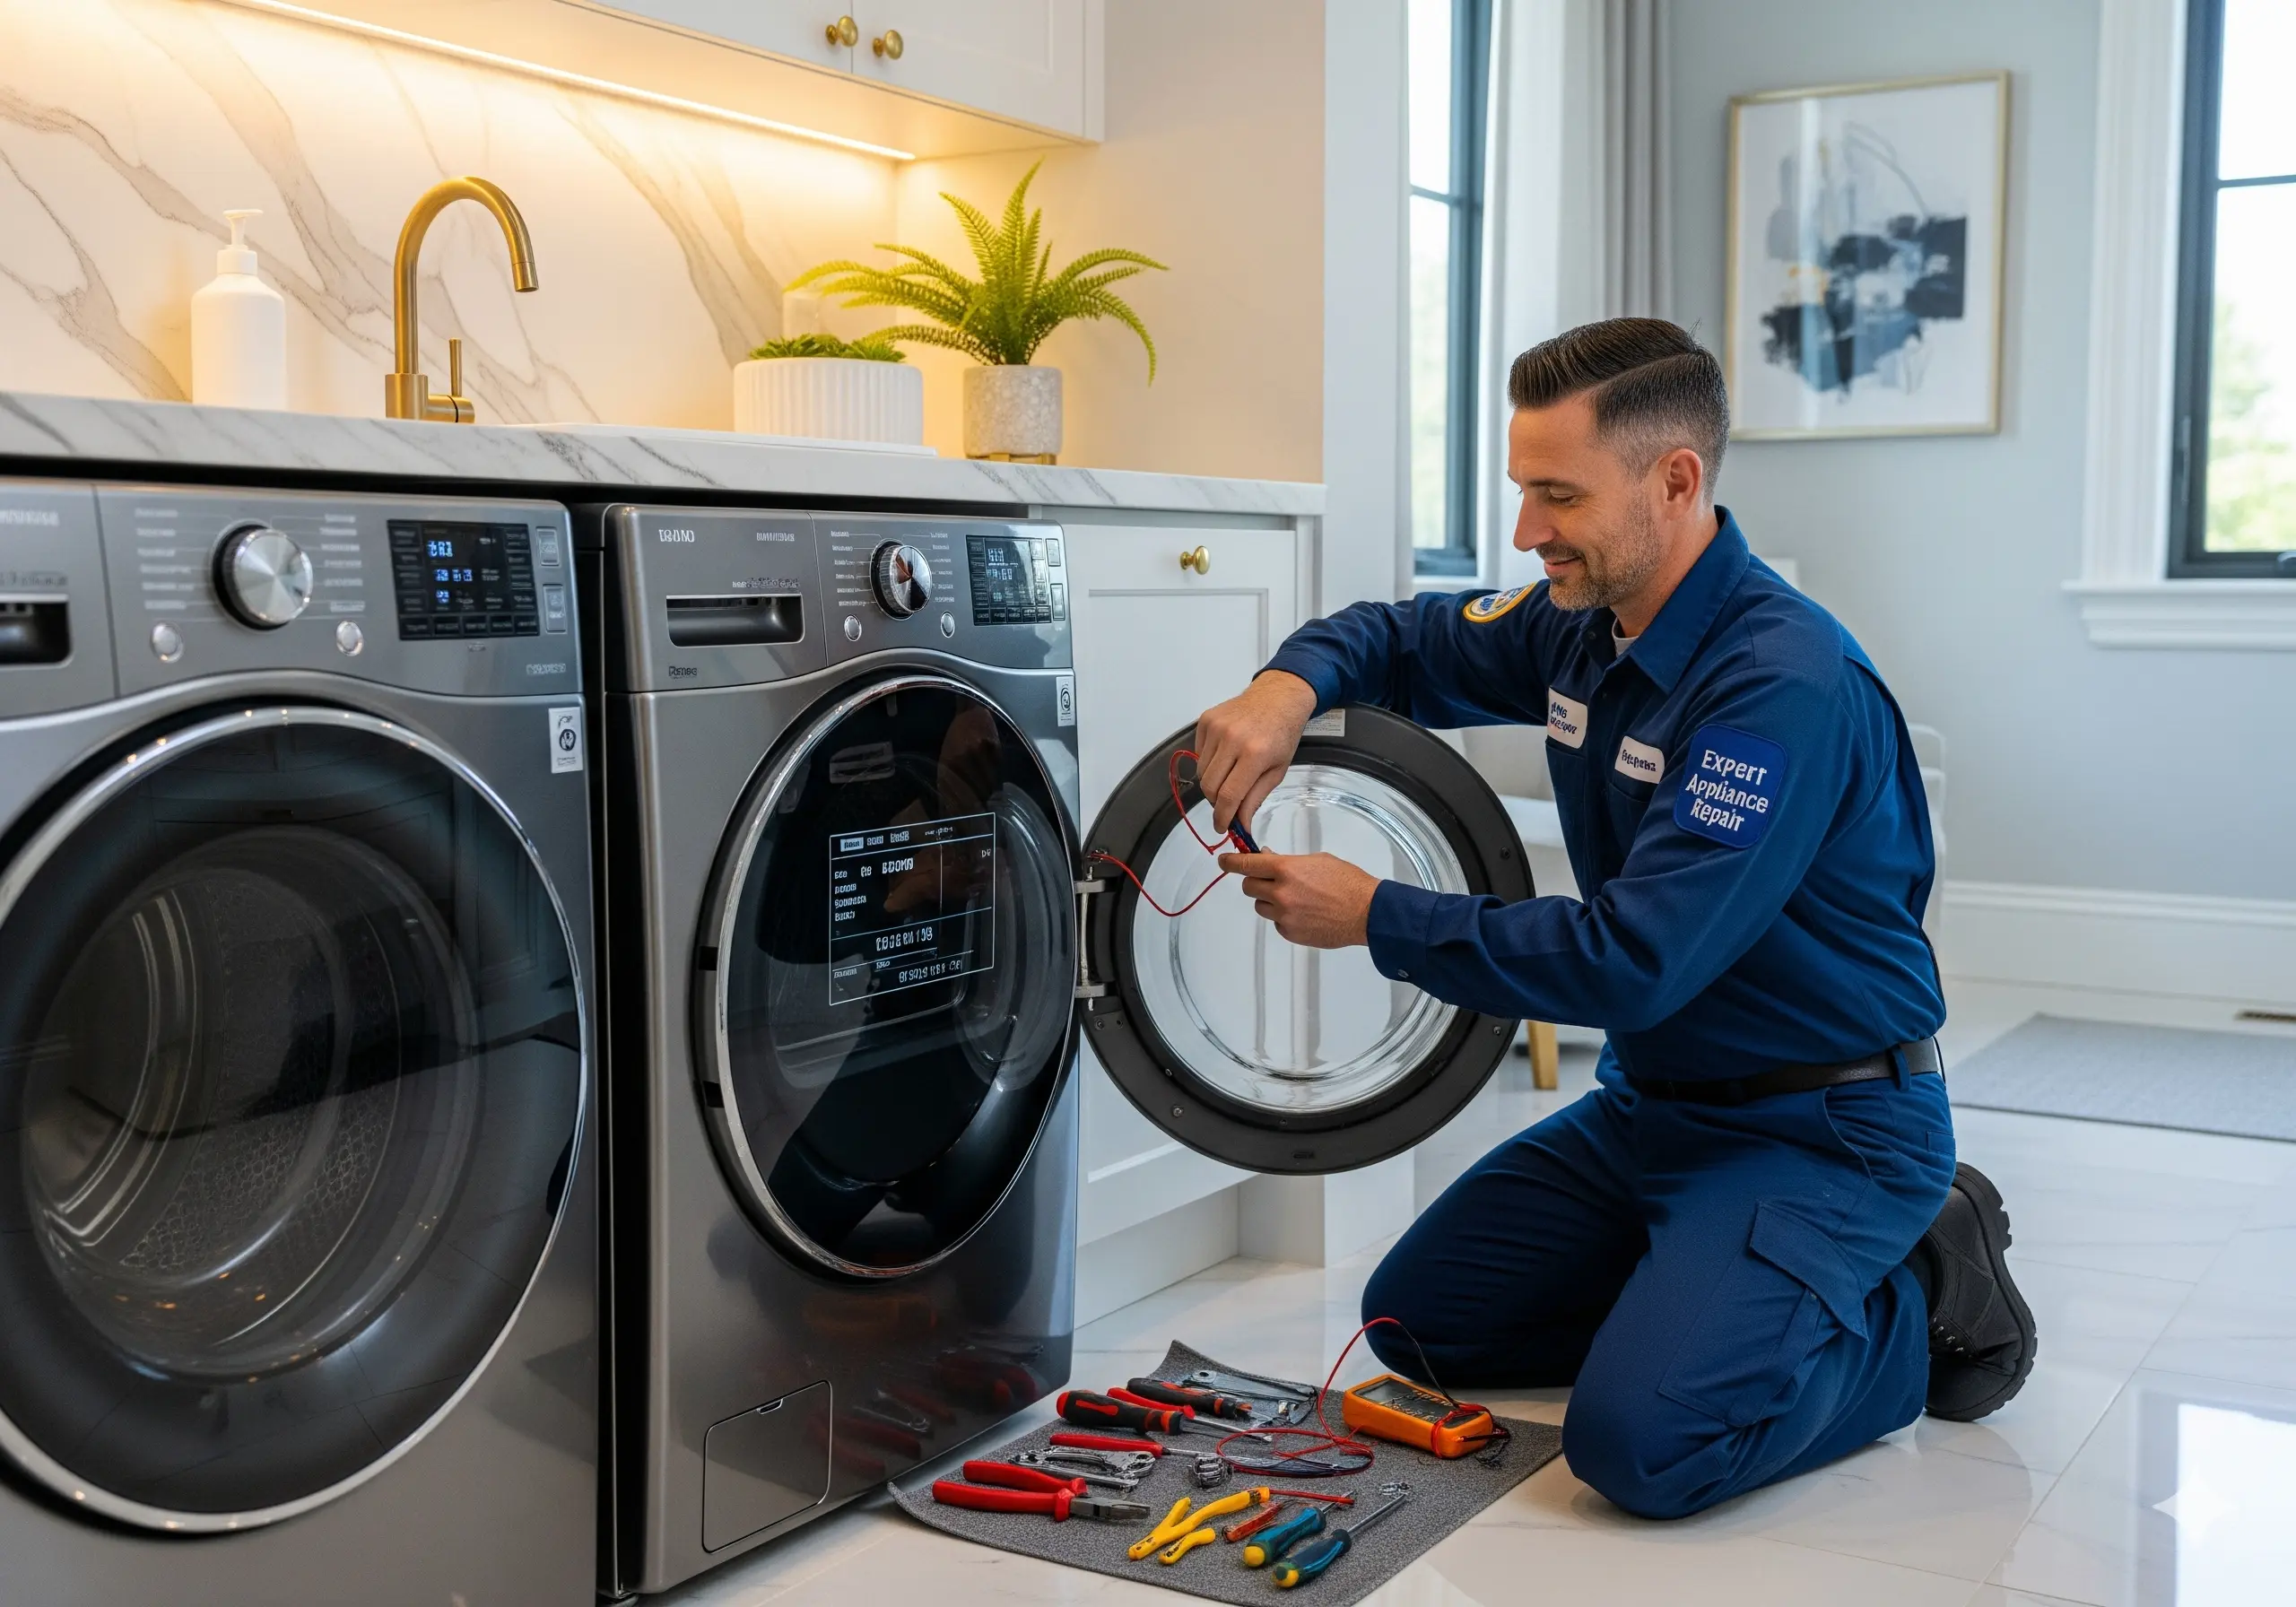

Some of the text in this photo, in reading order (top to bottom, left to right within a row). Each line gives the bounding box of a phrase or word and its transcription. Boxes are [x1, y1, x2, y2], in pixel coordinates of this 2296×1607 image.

[1701, 749, 1767, 786] Expert
[1685, 773, 1769, 813] Appliance
[1690, 798, 1744, 831] Repair
